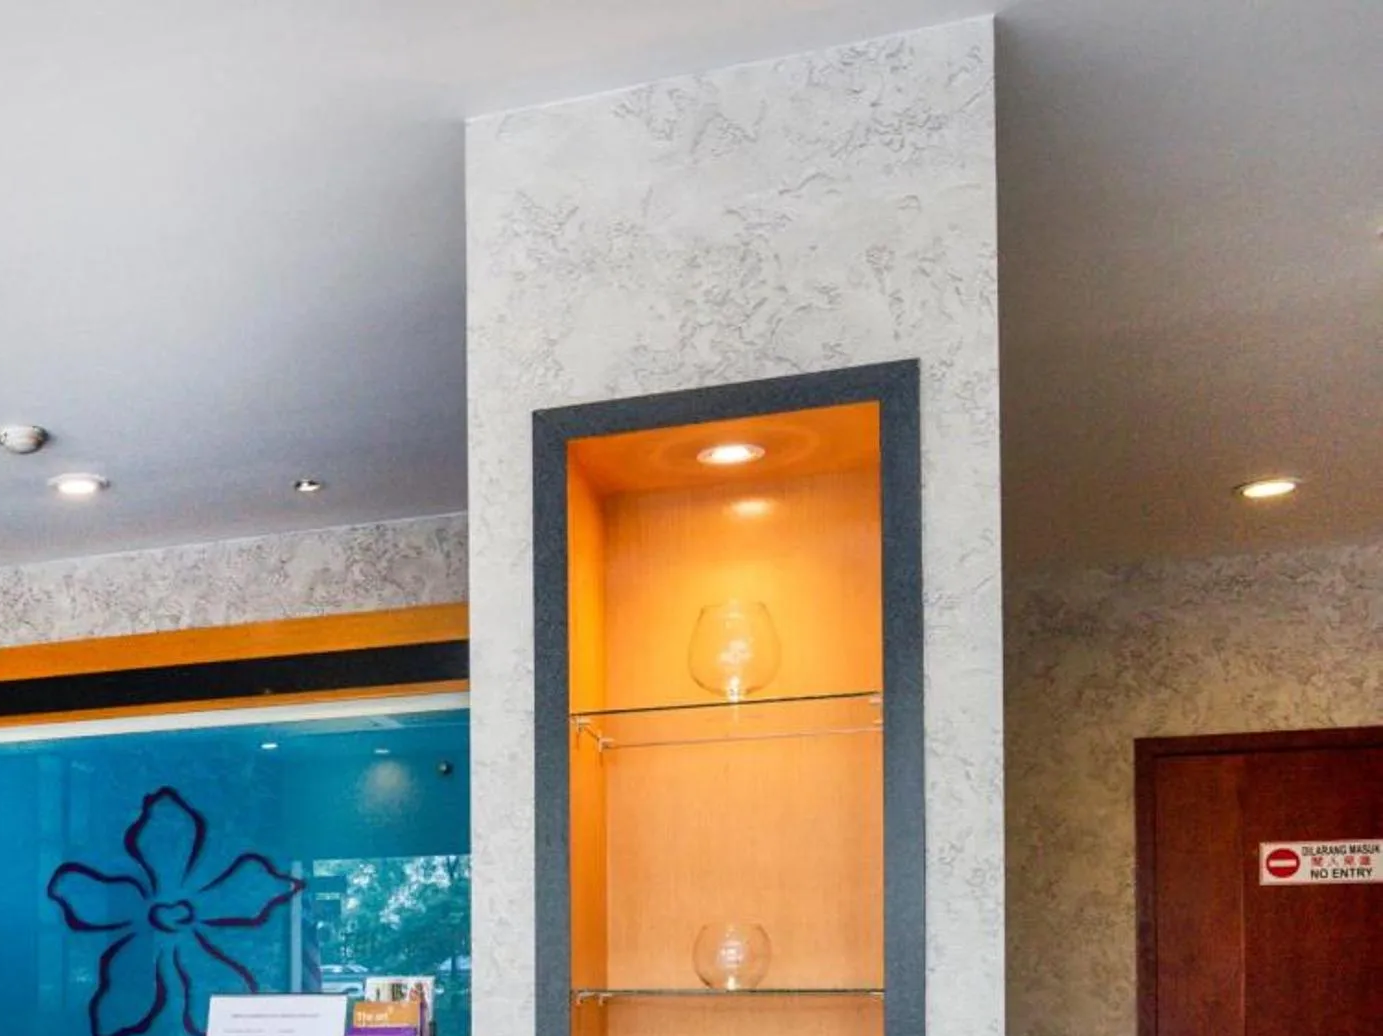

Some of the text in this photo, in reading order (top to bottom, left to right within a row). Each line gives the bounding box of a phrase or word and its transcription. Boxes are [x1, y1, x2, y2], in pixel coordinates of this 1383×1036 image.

[1301, 843, 1380, 856] DILARANG MASUK
[1310, 867, 1373, 879] NO ENTRY
